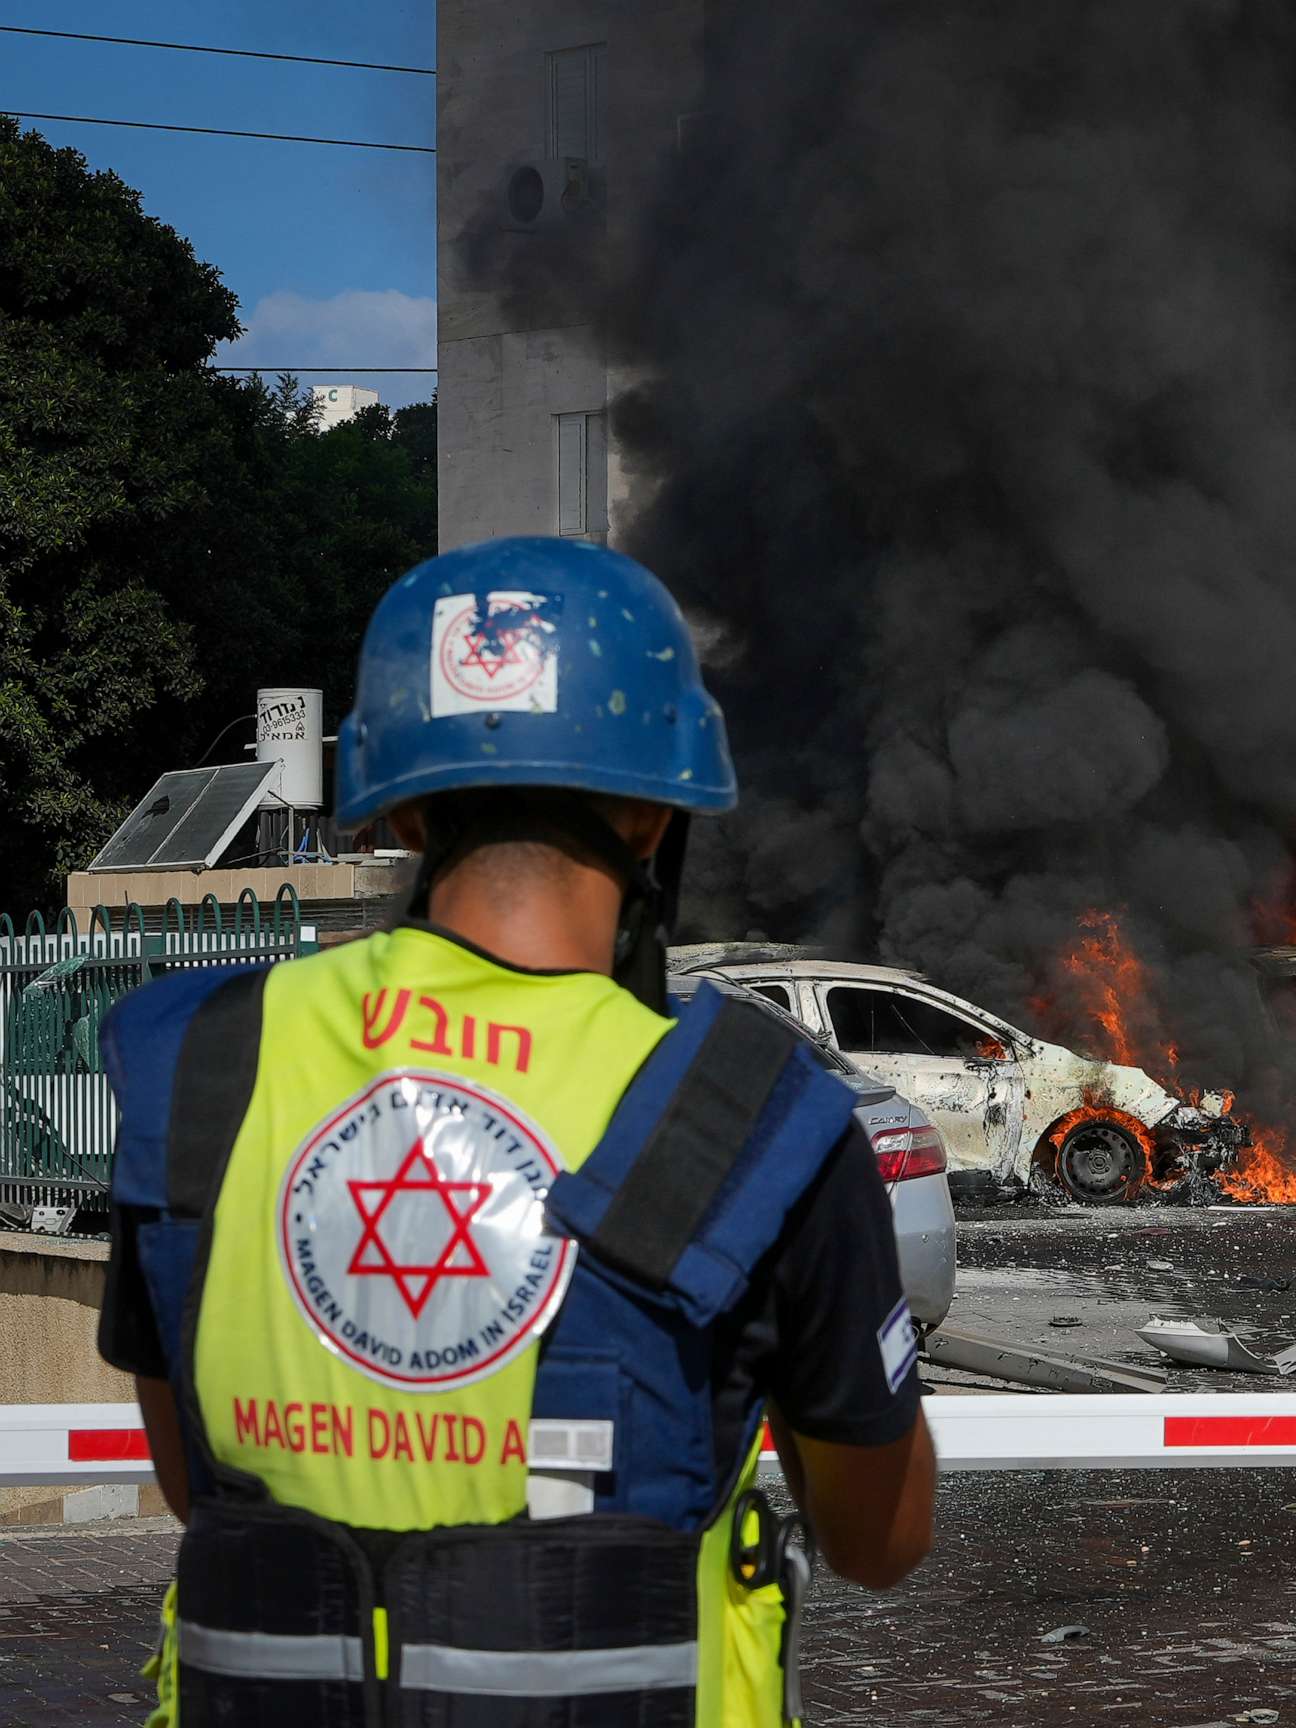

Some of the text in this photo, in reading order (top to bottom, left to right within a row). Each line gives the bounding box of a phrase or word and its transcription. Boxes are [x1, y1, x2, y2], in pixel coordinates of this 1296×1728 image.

[362, 987, 533, 1073] חובש
[293, 1103, 381, 1197] בישראל
[297, 1239, 552, 1370] MAGEN DAVID ADOM IN ISRAEL
[234, 1397, 354, 1457] MAGEN
[367, 1408, 487, 1465] DAVID
